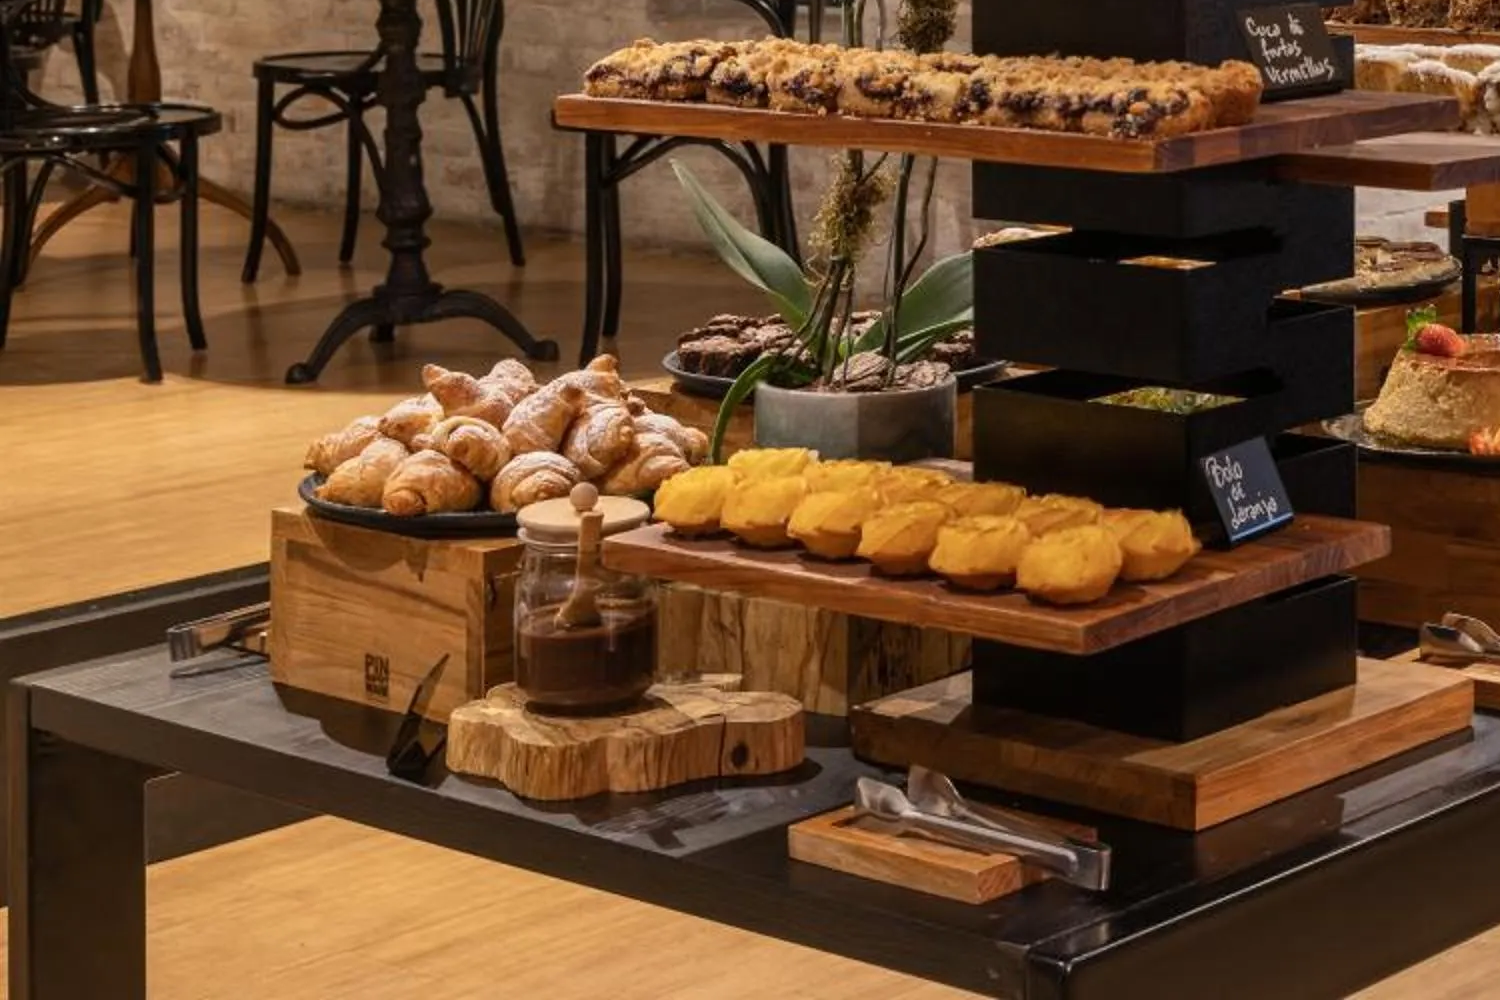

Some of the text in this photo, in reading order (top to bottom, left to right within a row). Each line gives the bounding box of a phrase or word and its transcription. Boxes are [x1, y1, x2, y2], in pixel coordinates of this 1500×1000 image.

[1245, 16, 1281, 38] Cuca
[1261, 37, 1302, 64] frutas
[1205, 455, 1243, 489] Bolo
[365, 652, 389, 677] PIN
